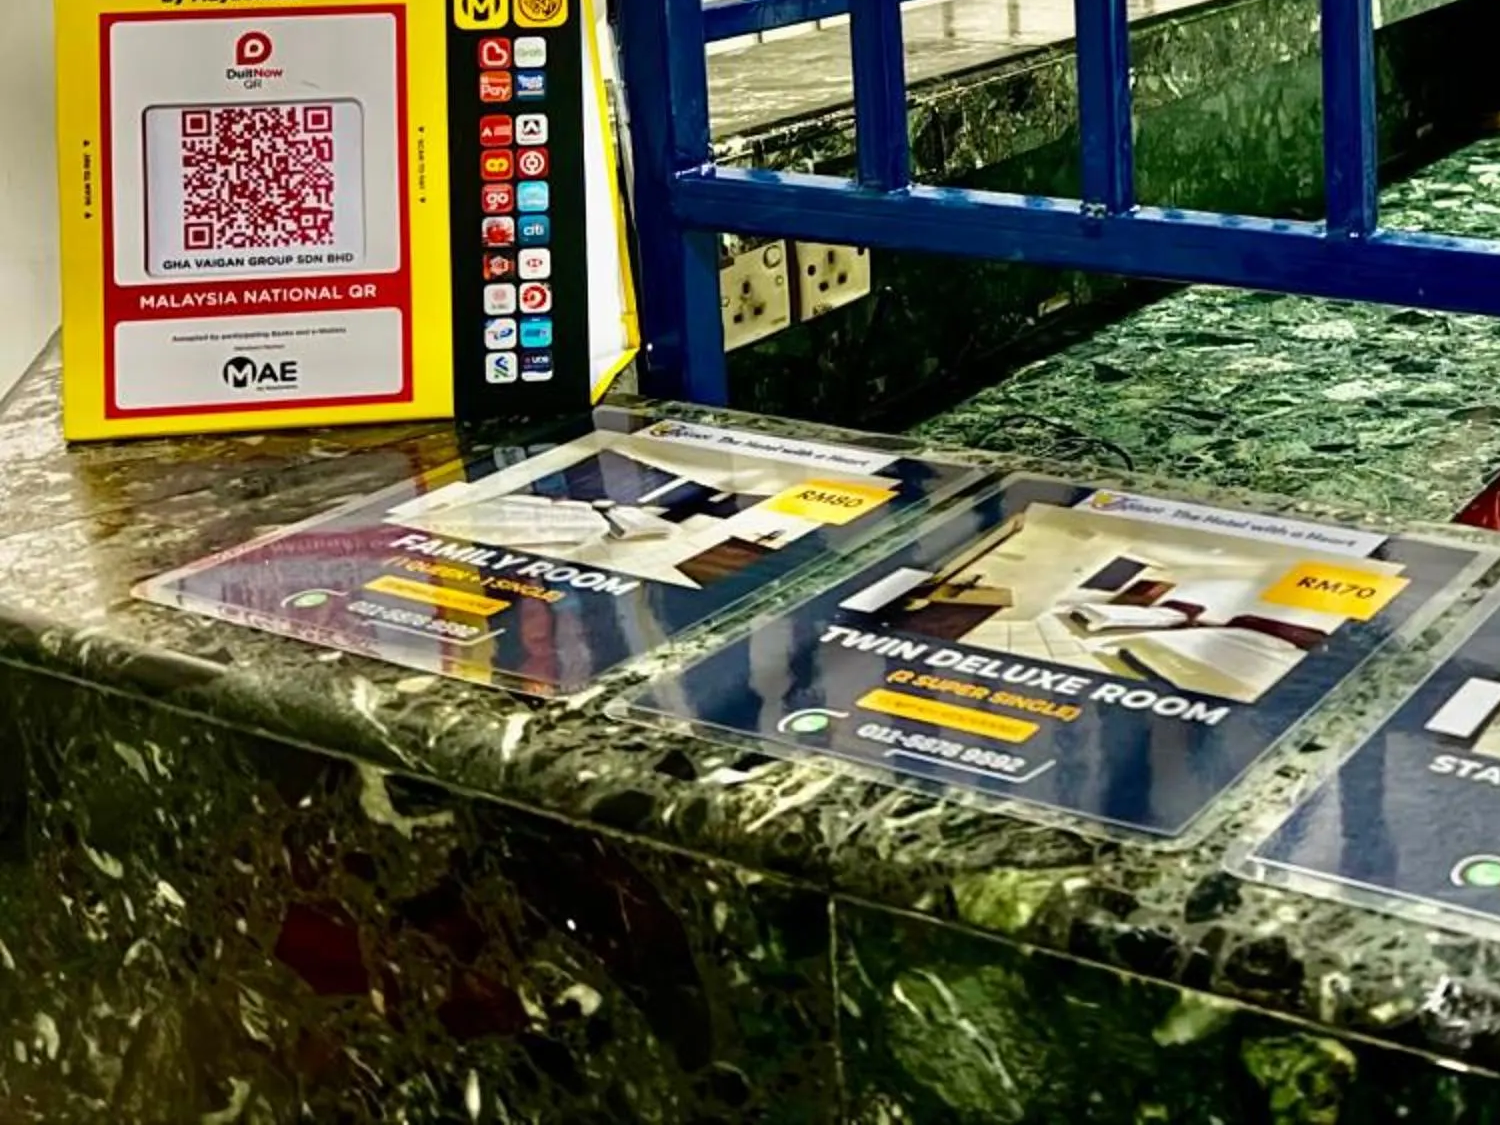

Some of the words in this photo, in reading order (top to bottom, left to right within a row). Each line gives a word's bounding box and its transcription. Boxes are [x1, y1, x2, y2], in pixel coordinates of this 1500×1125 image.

[226, 67, 283, 80] DuitNow
[523, 222, 545, 236] citi
[162, 260, 190, 270] GHA
[195, 257, 244, 269] VAIGAN
[247, 255, 293, 267] GROUP
[297, 253, 323, 264] SDN
[327, 252, 354, 263] BHD
[139, 291, 237, 309] MALAYSIA
[243, 286, 342, 305] NATIONAL
[349, 284, 377, 299] QR
[223, 356, 298, 388] MAE
[795, 489, 864, 509] RM80
[1171, 507, 1205, 522] The
[1202, 514, 1249, 531] Hotel
[1249, 523, 1288, 537] with
[1304, 531, 1358, 548] Heart
[389, 533, 527, 570] FAMILY
[517, 562, 640, 596] ROOM
[1296, 575, 1377, 600] RM70
[819, 625, 928, 661] TWIN
[924, 647, 1095, 697] DELUXE
[1089, 680, 1230, 727] ROOM
[912, 674, 990, 700] SUPER
[988, 690, 1083, 723] SINGLE)
